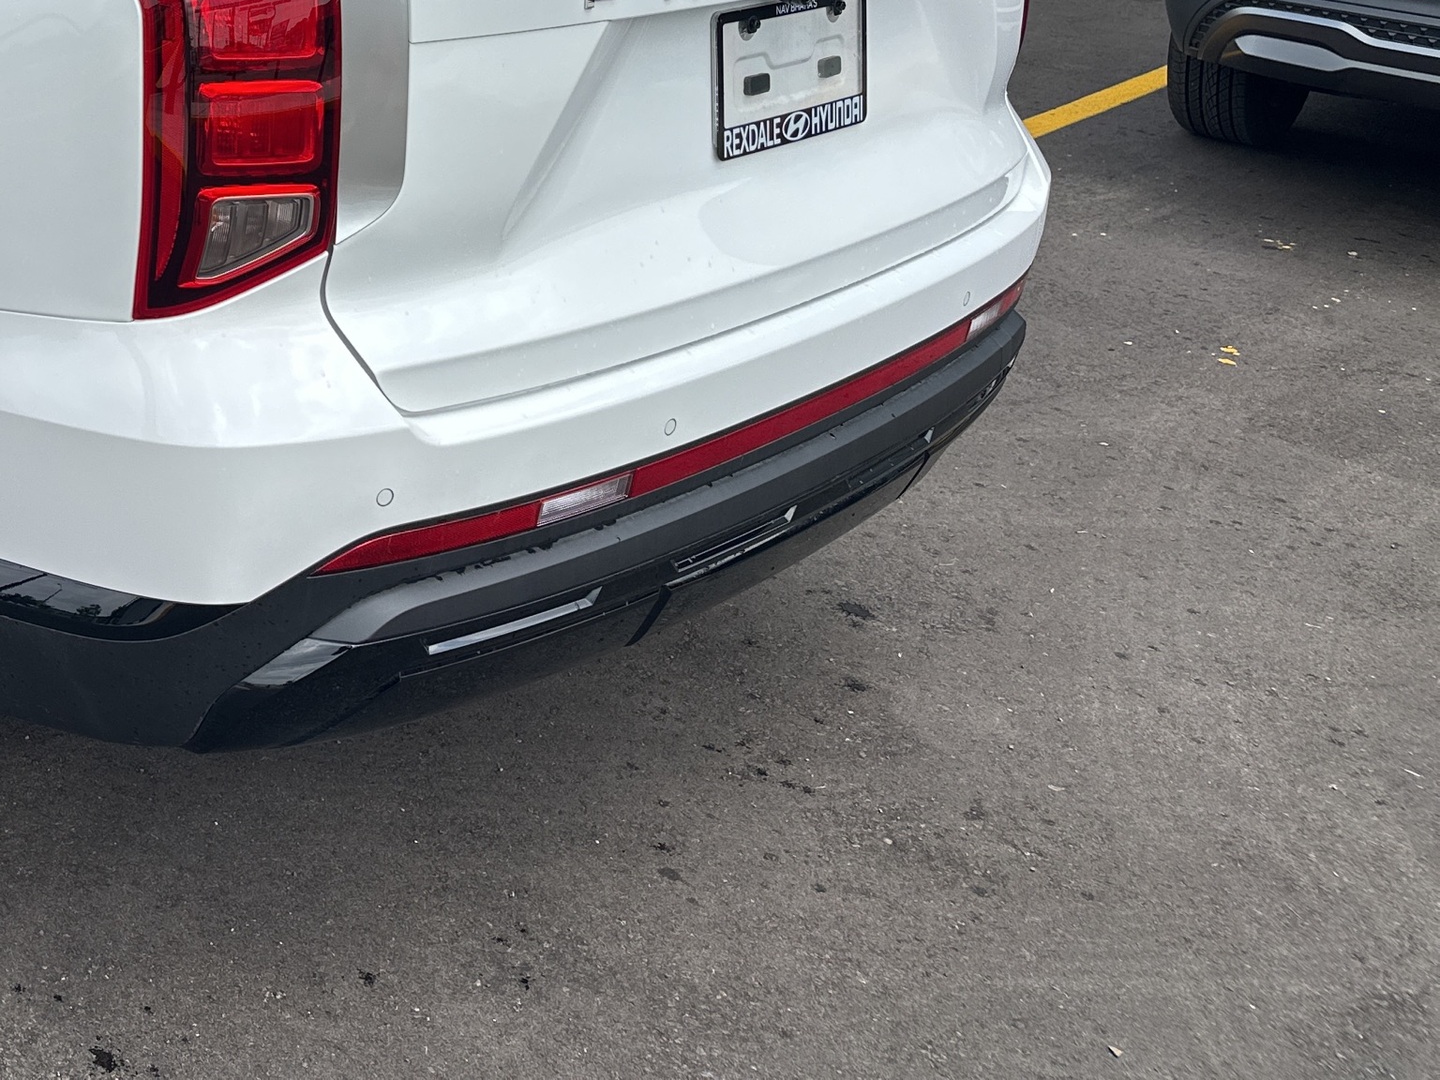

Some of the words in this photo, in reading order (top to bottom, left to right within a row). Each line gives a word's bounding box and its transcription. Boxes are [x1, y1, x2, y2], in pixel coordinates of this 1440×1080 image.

[776, 4, 790, 15] NAV
[724, 117, 781, 158] REXDALE
[811, 95, 863, 134] HYUNDAI
